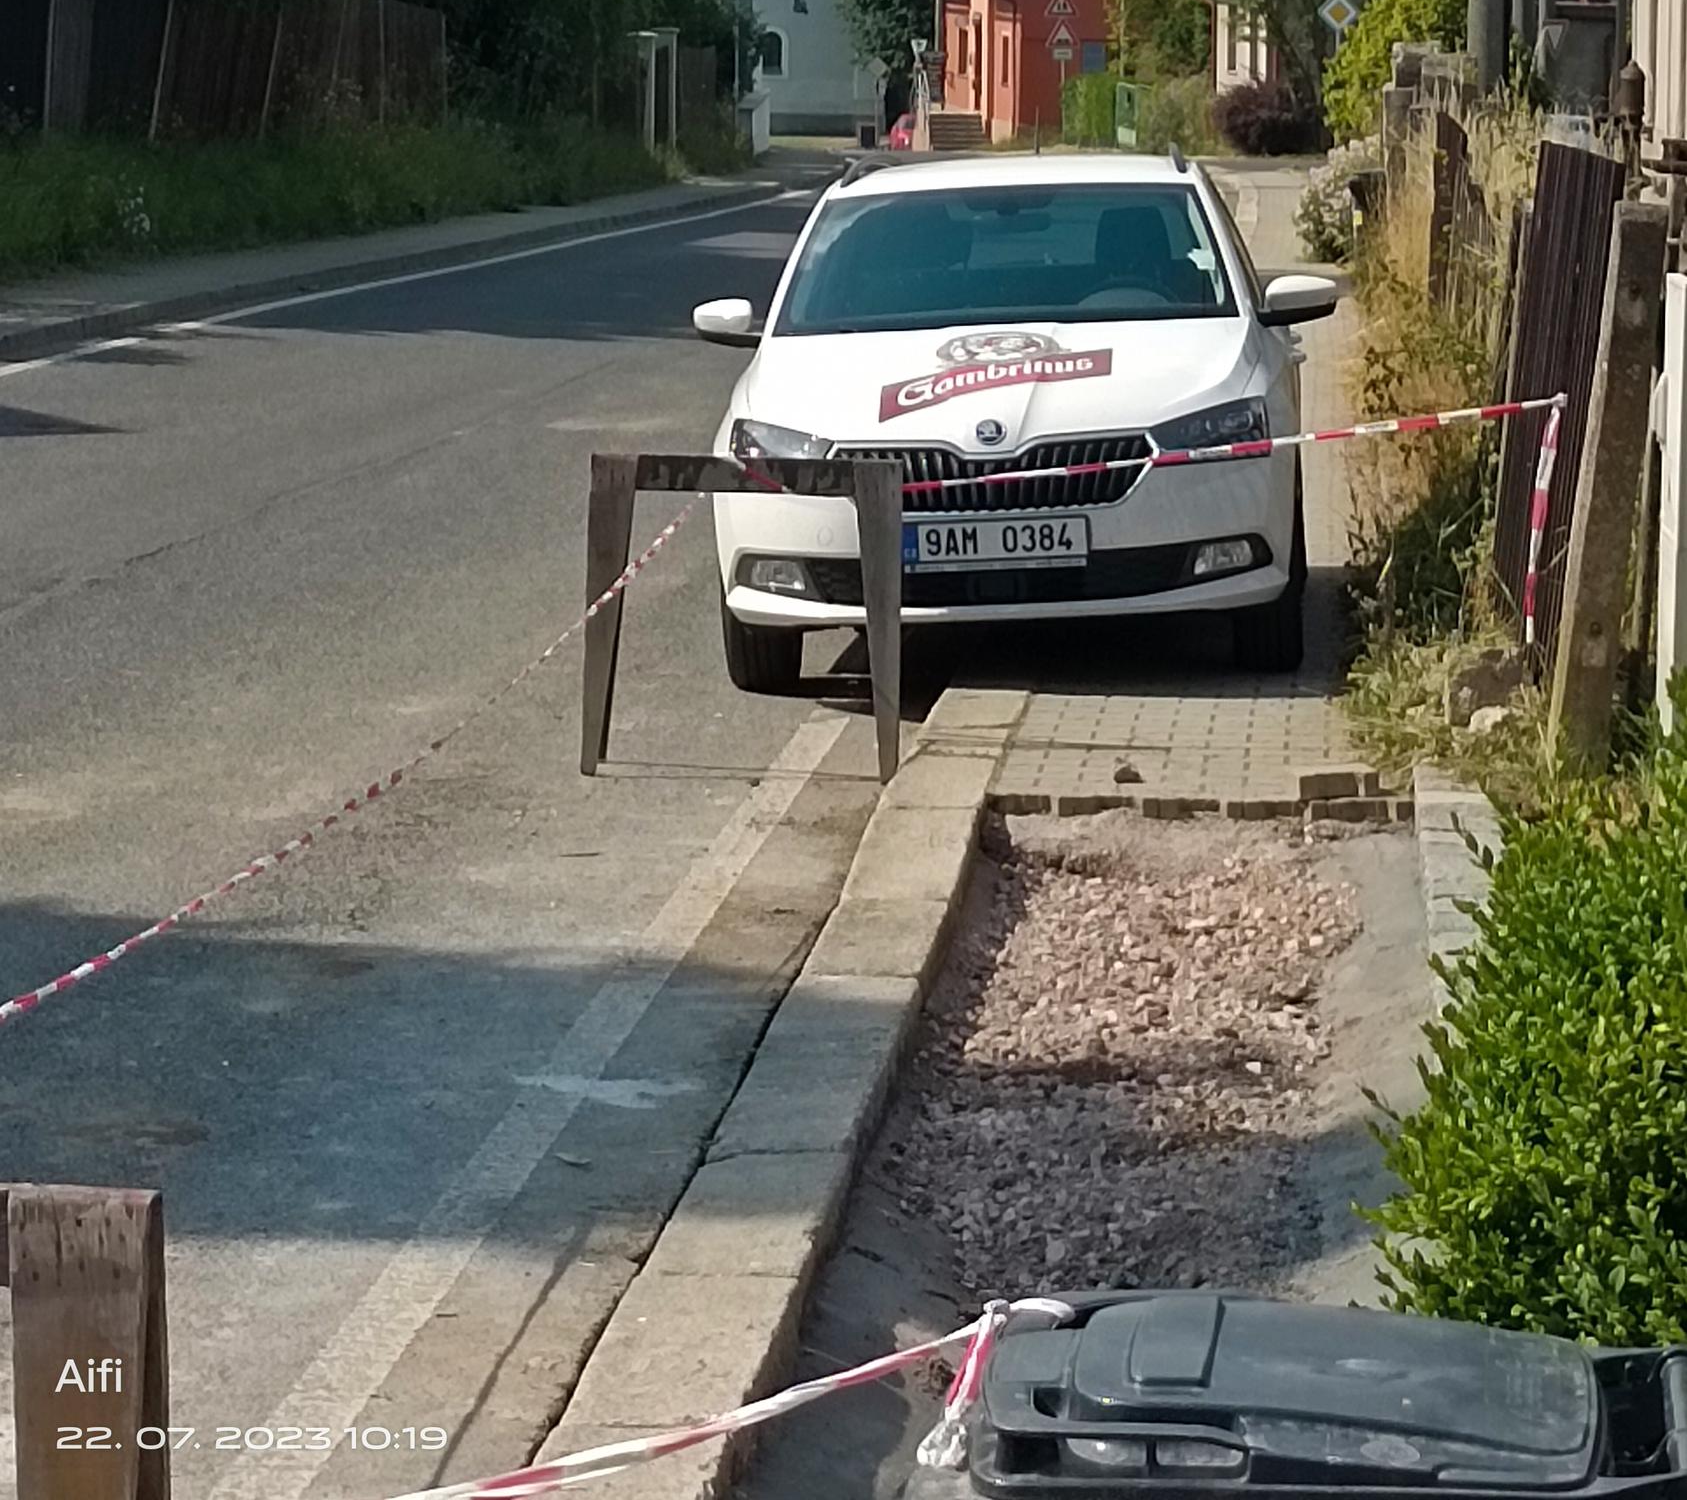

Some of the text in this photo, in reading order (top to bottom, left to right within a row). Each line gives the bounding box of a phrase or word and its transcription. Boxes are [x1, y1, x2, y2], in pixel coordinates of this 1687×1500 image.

[898, 357, 1094, 406] Gambrinus
[926, 522, 1073, 556] 9AM 0384
